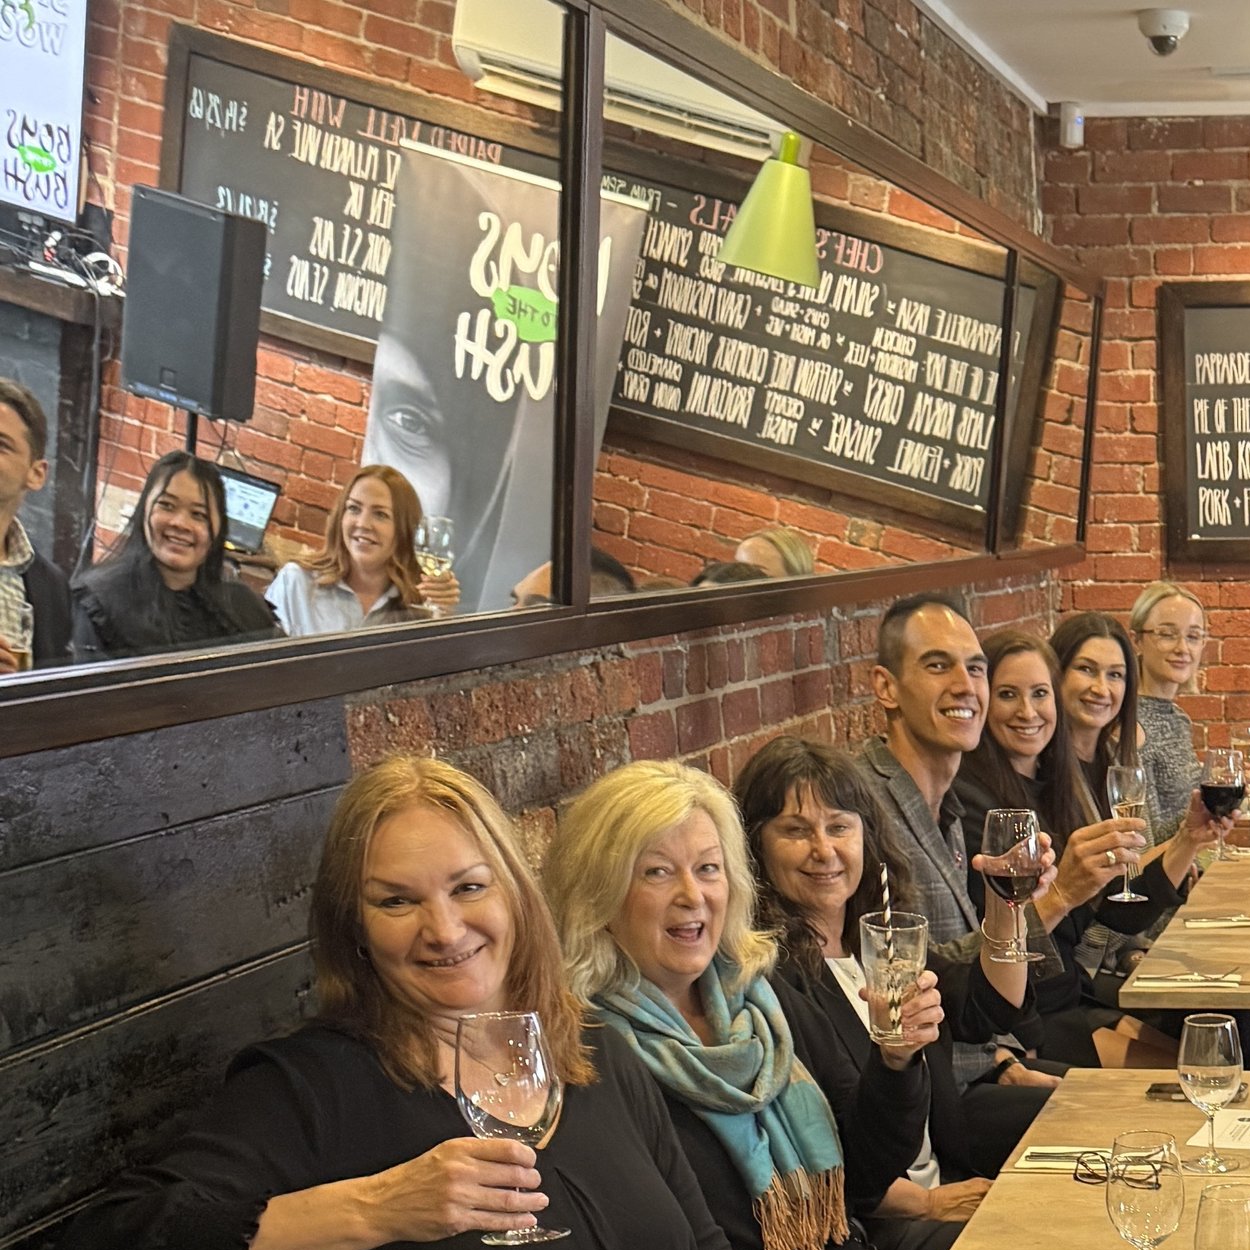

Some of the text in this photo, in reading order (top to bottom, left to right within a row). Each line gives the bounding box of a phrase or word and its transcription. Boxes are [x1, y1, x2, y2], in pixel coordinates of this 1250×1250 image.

[1194, 398, 1211, 434] PIE
[1214, 398, 1228, 433] OF
[1196, 440, 1233, 480] LAMB
[1198, 486, 1232, 527] PORK
